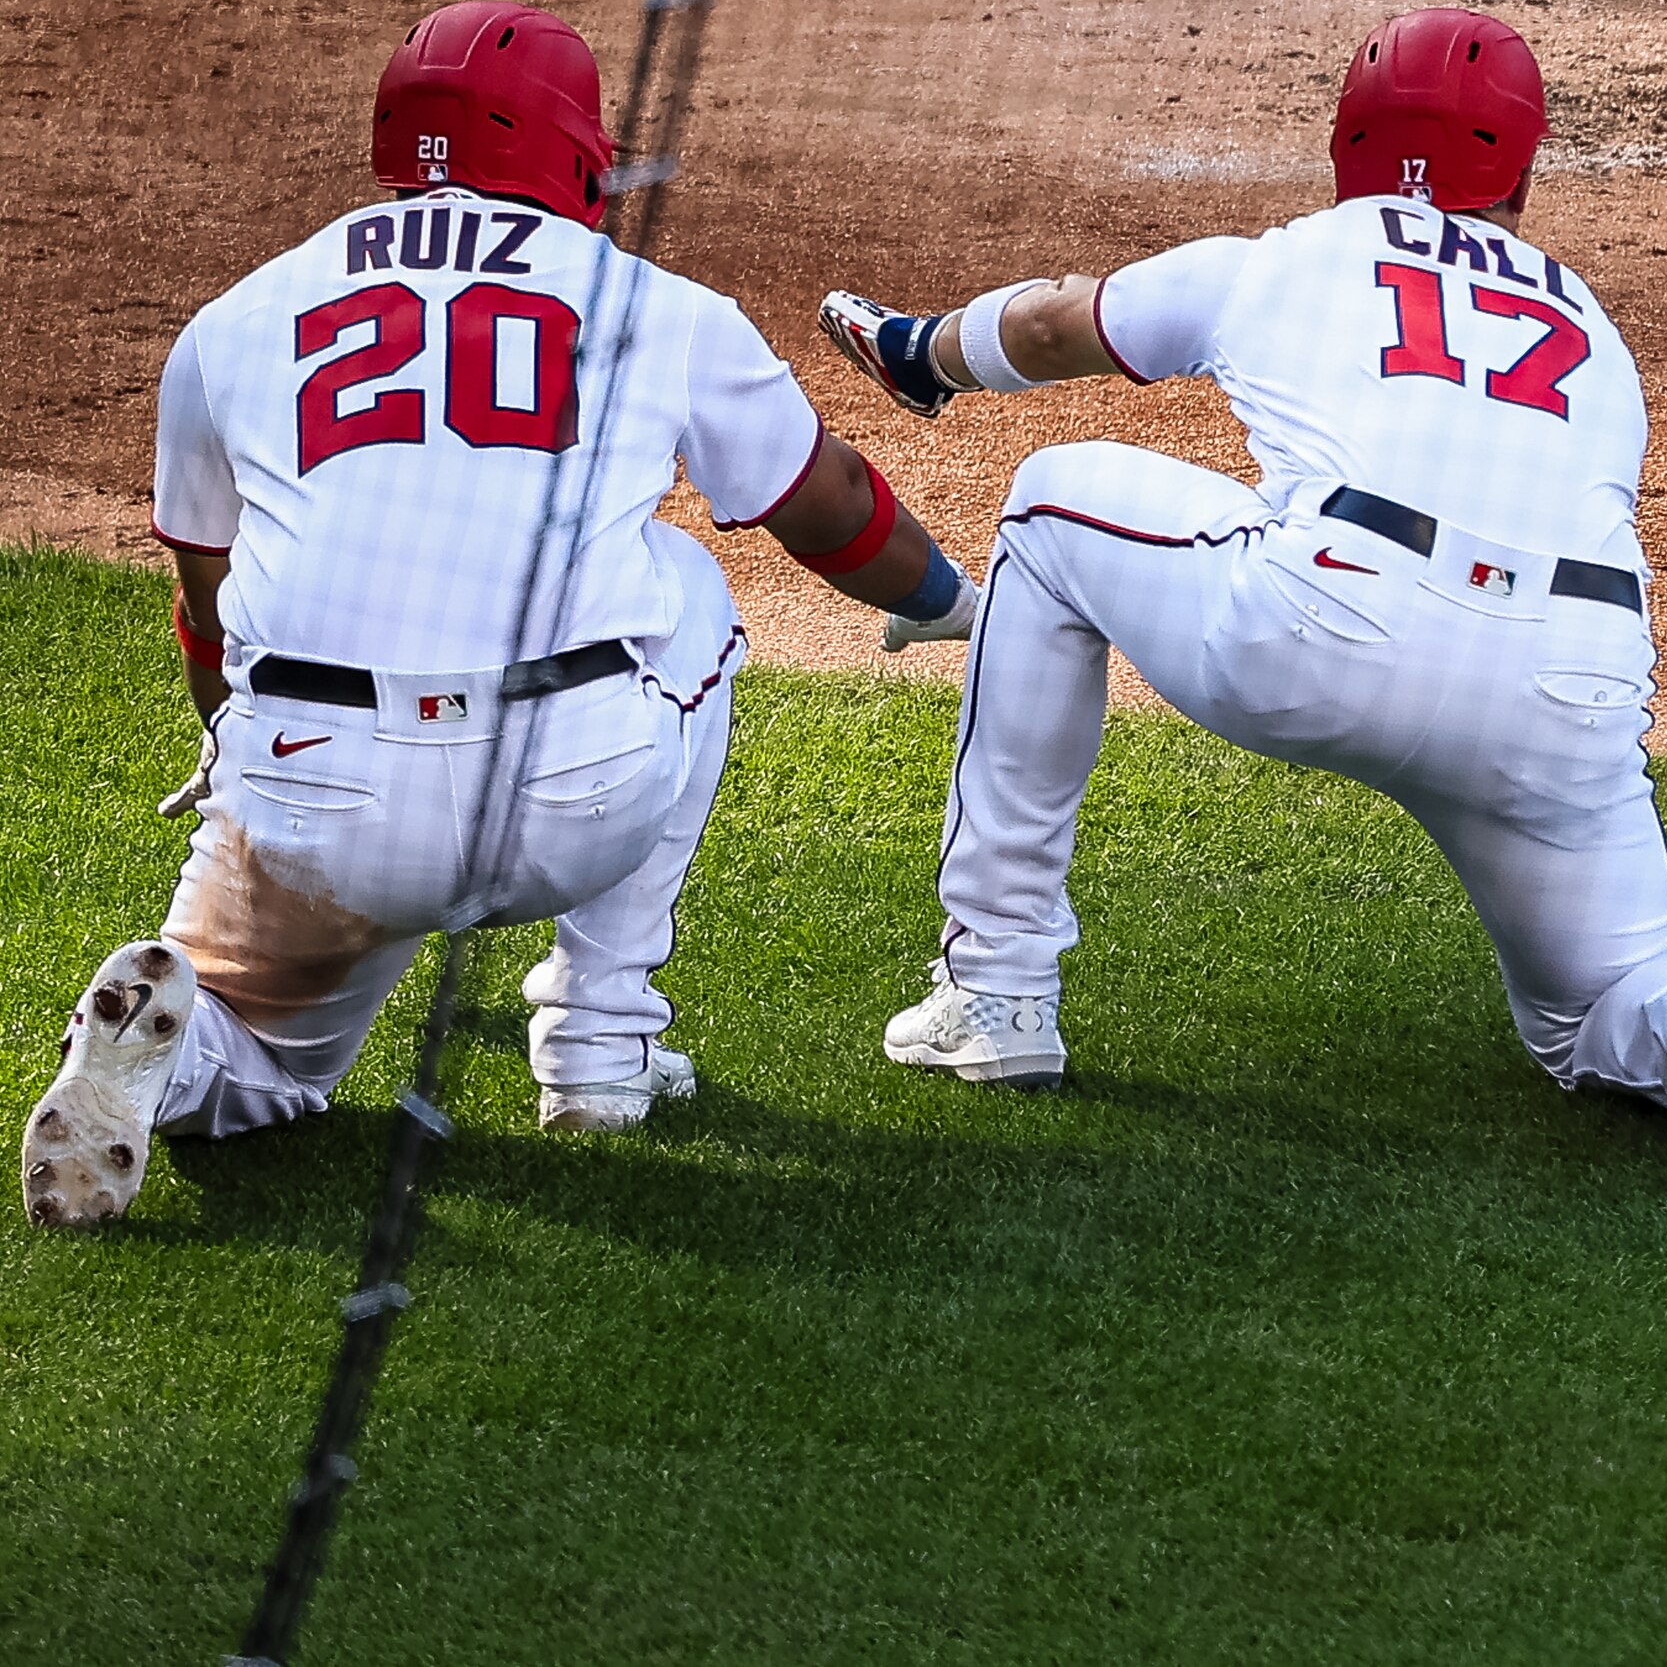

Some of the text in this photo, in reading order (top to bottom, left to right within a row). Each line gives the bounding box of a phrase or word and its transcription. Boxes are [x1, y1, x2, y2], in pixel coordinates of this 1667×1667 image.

[418, 135, 448, 161] 20
[1402, 159, 1427, 183] 17
[346, 207, 544, 276] RUIZ
[1374, 260, 1593, 424] 17
[294, 280, 583, 480] 20
